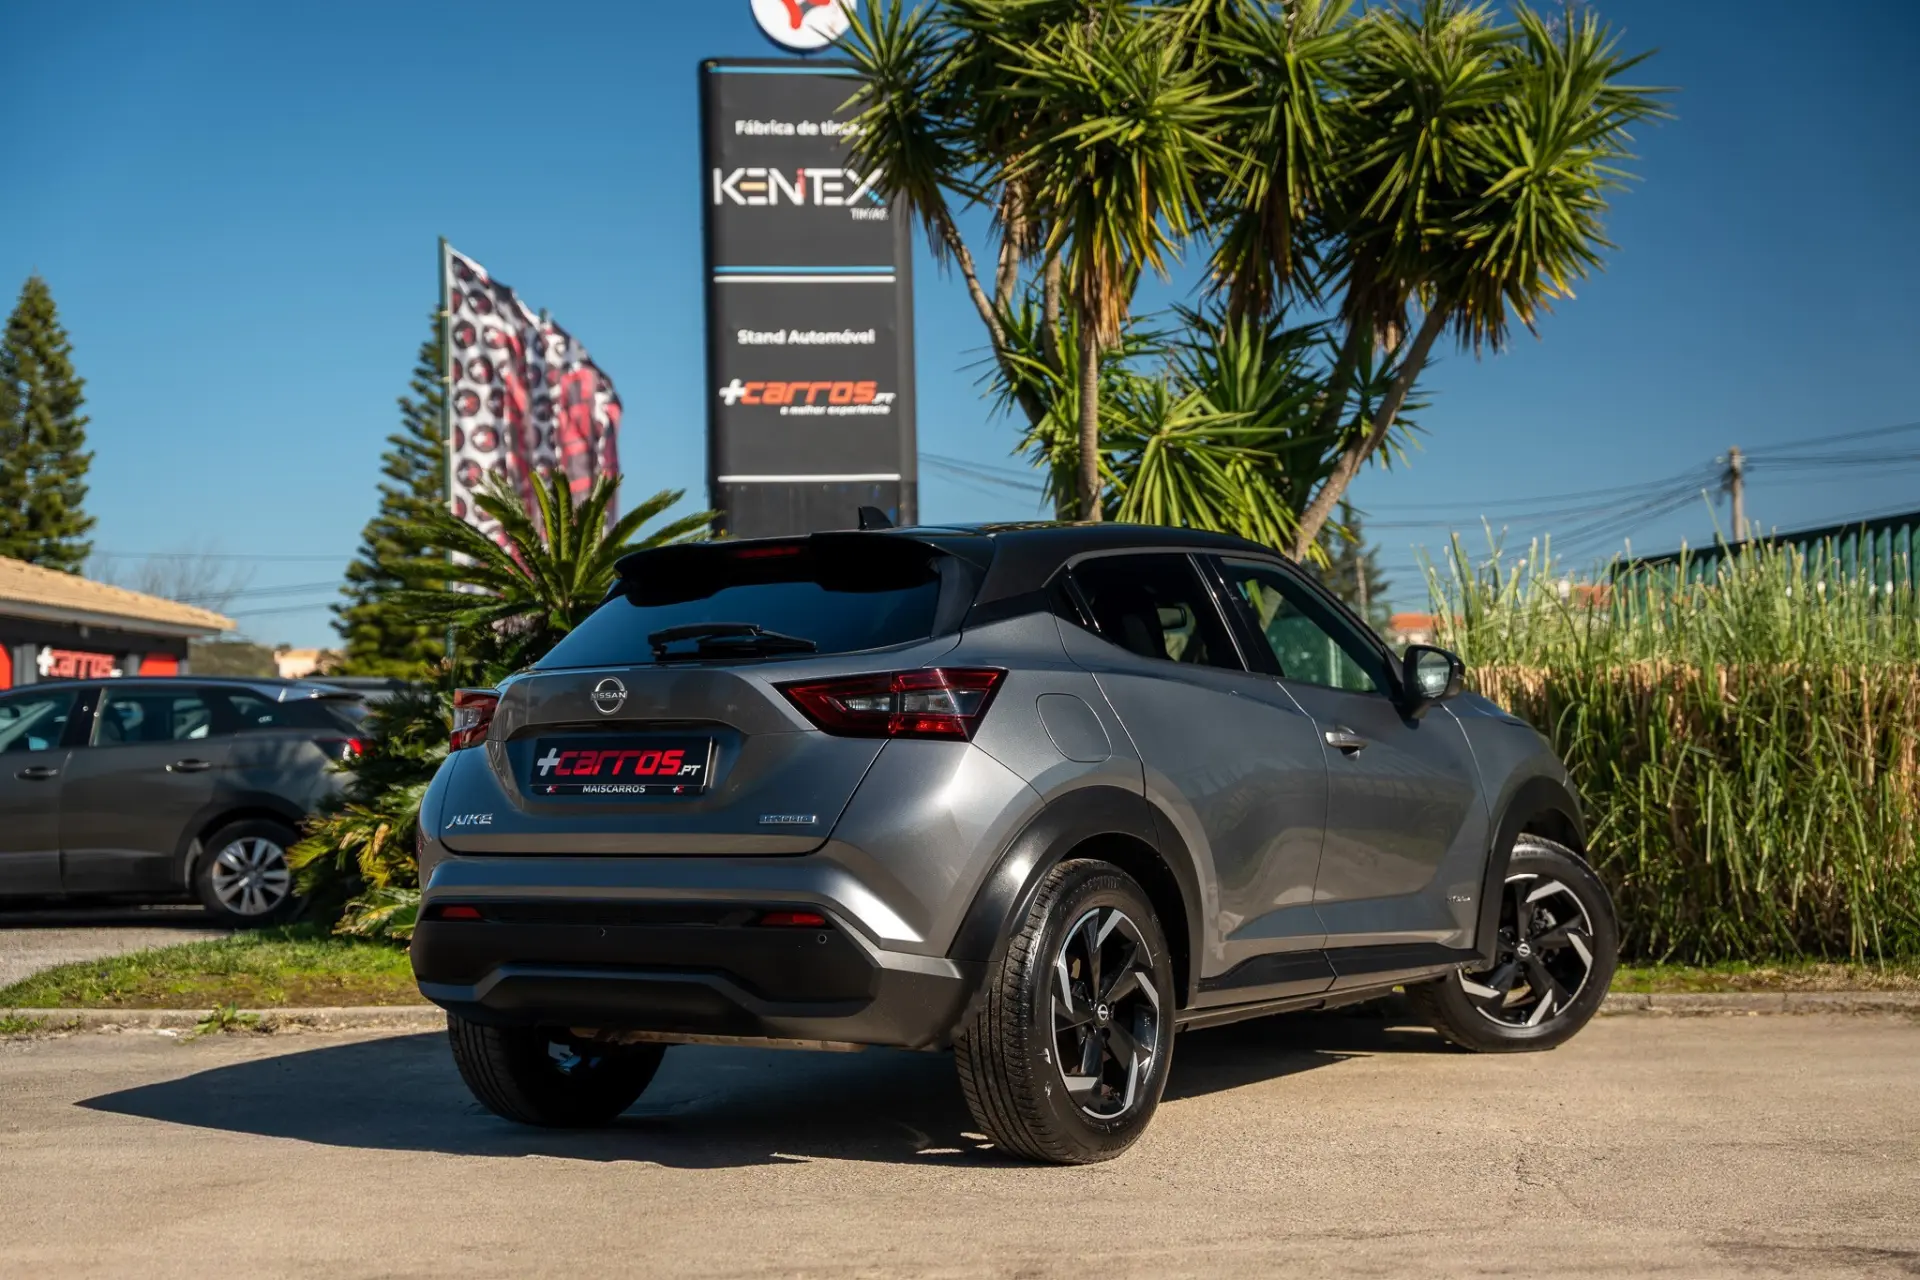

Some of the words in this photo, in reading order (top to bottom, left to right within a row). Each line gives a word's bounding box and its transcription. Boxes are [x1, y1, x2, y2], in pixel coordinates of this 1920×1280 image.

[735, 119, 795, 136] Fábrica
[797, 120, 819, 136] de
[737, 328, 786, 345] Stand
[788, 328, 876, 345] Automóvel
[591, 691, 627, 700] NISSAN
[582, 785, 646, 794] MAISCARROS
[445, 812, 494, 830] JUKE
